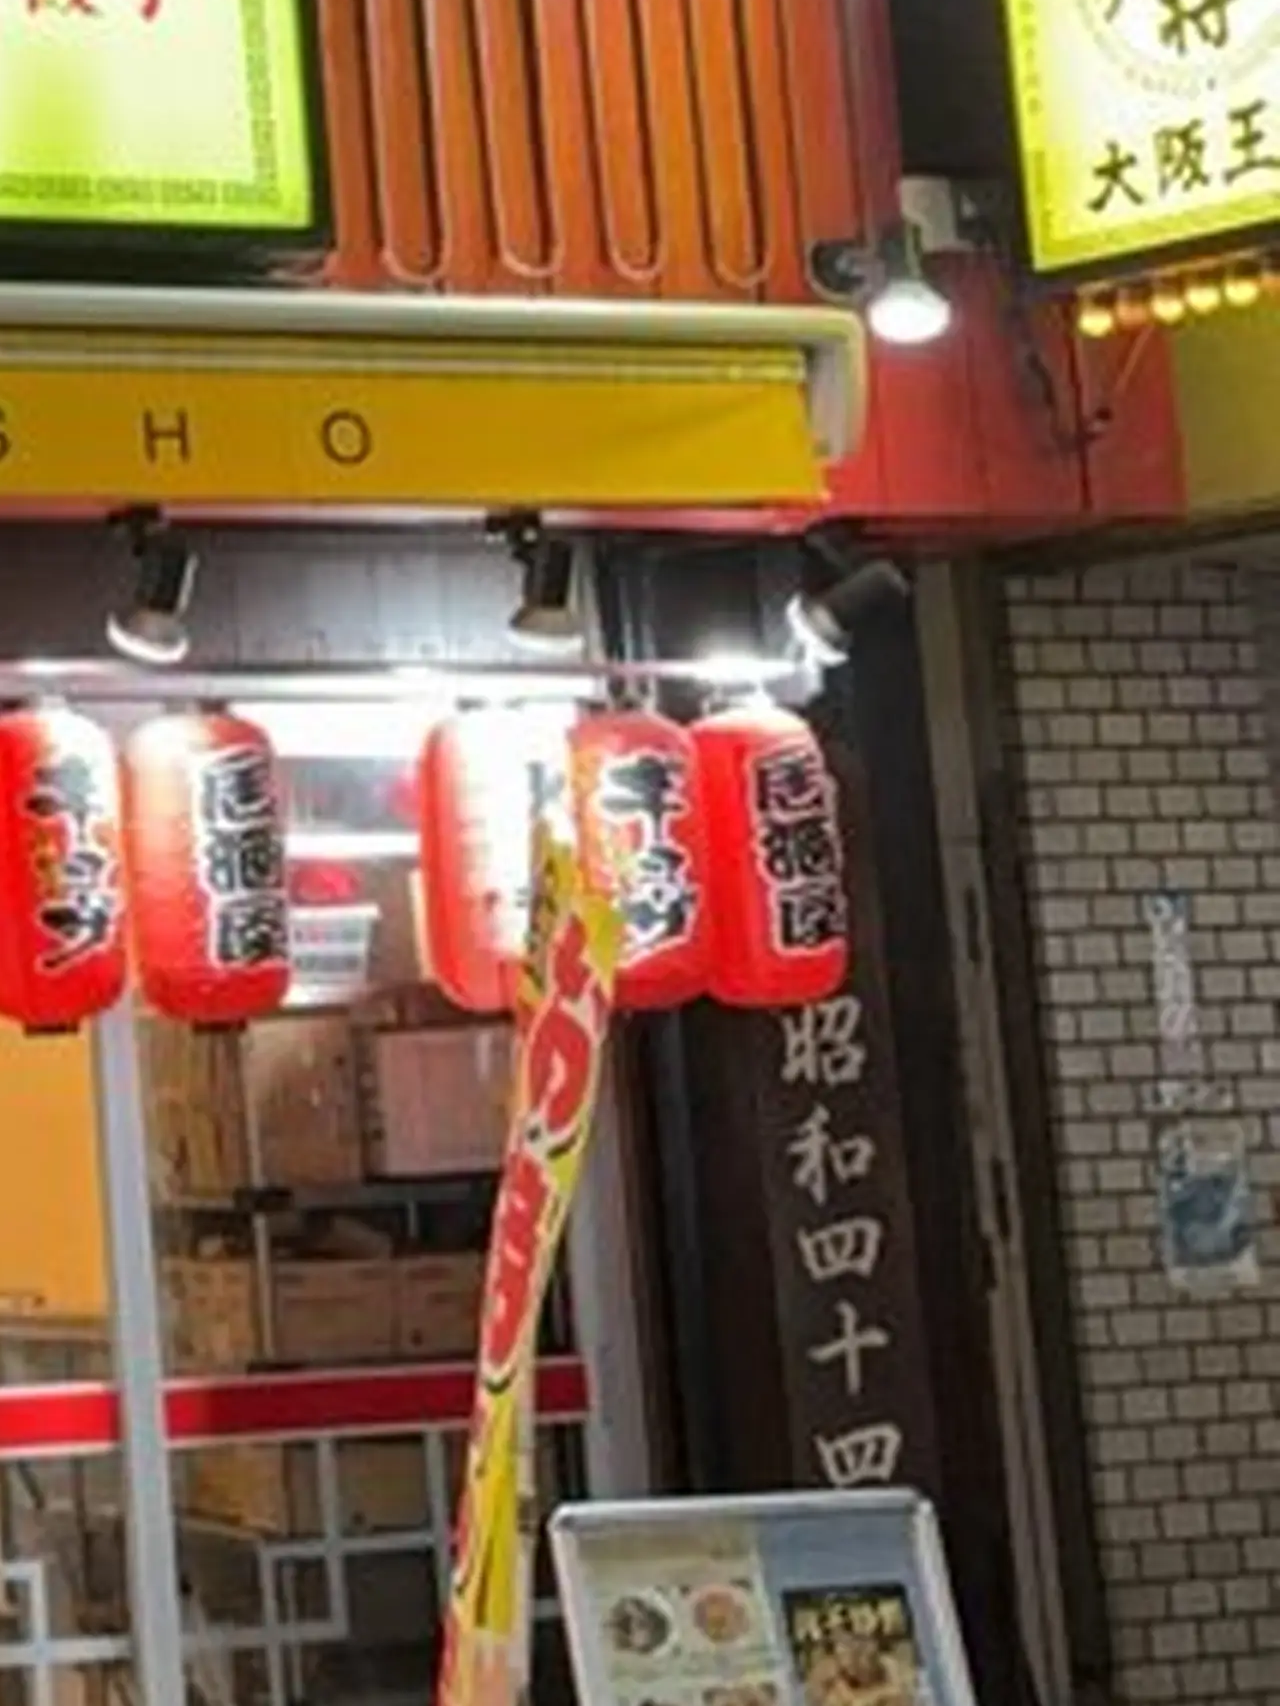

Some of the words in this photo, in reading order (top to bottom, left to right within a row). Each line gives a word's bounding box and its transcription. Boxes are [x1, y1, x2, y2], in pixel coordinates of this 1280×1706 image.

[778, 996, 901, 1486] 昭和四十四
